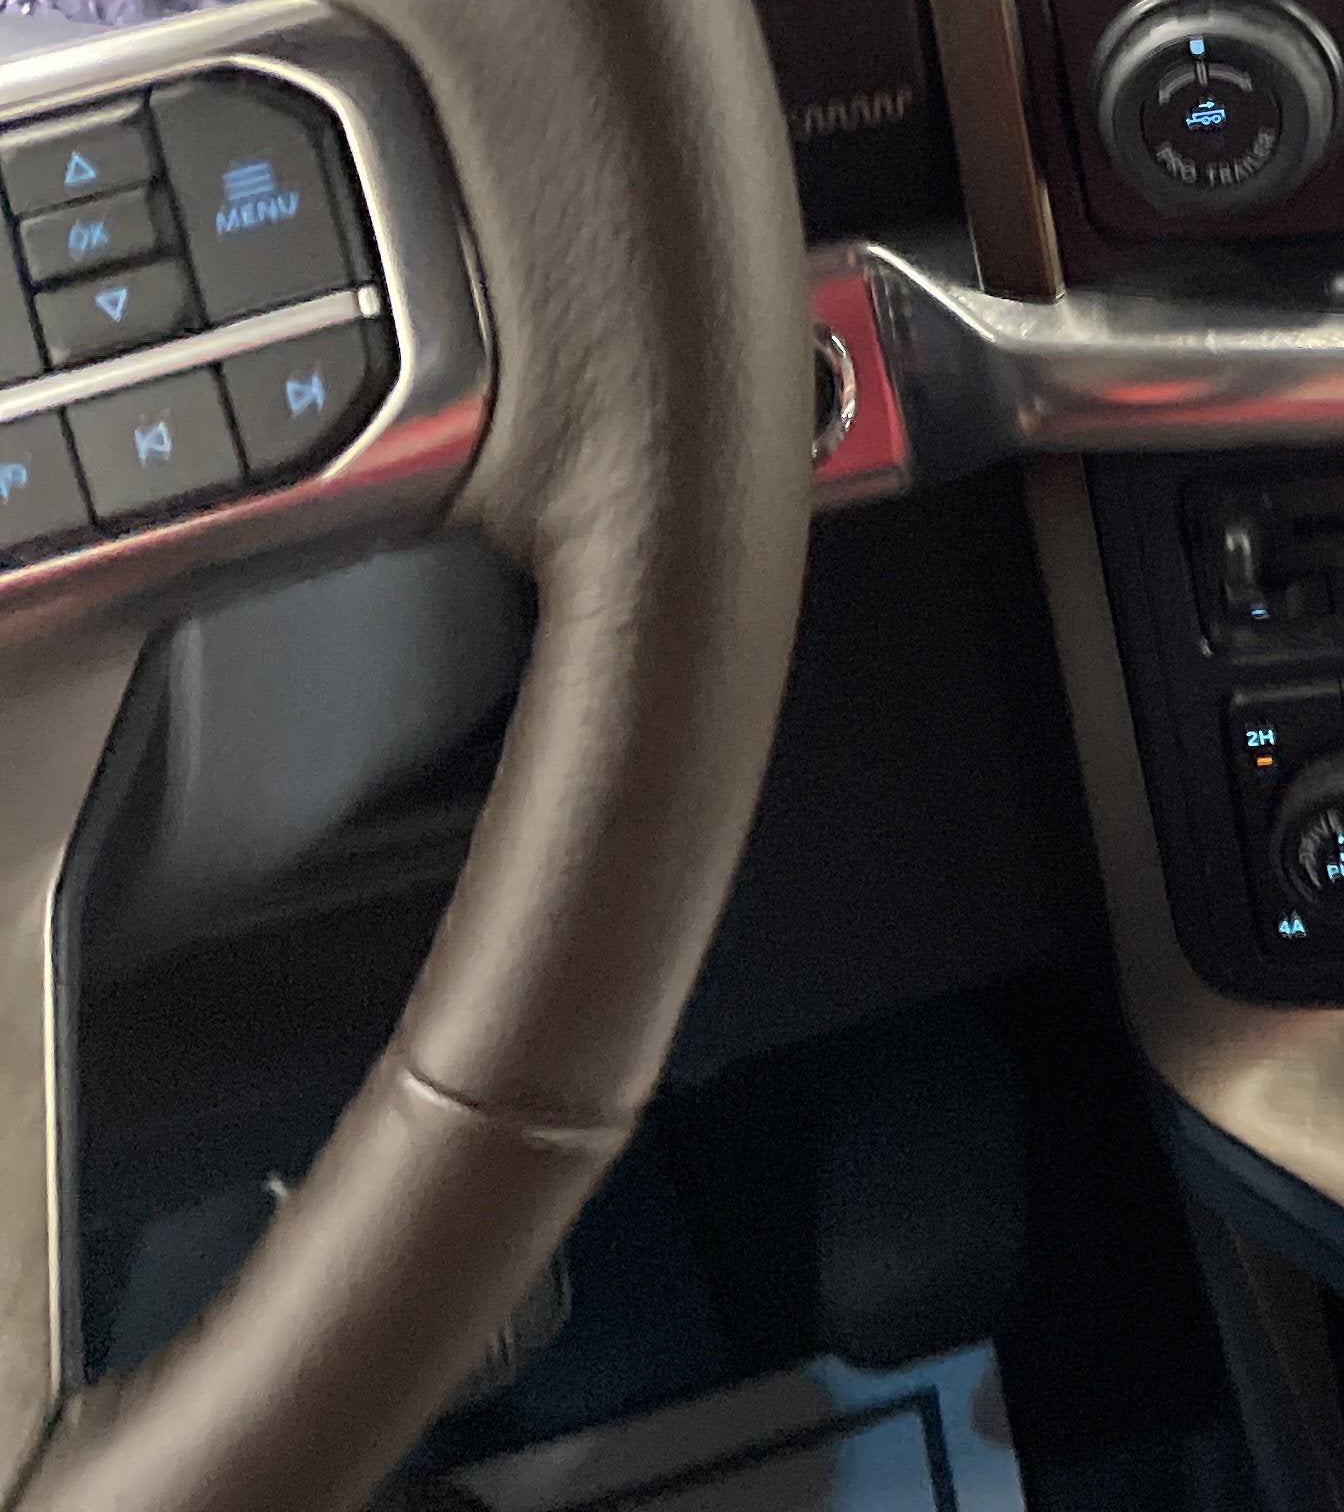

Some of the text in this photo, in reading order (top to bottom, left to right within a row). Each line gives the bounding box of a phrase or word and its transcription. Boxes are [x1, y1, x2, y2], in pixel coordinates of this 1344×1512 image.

[215, 192, 299, 234] MENU
[68, 221, 108, 257] OK
[1246, 730, 1275, 747] 2H
[1278, 918, 1306, 936] 4A
